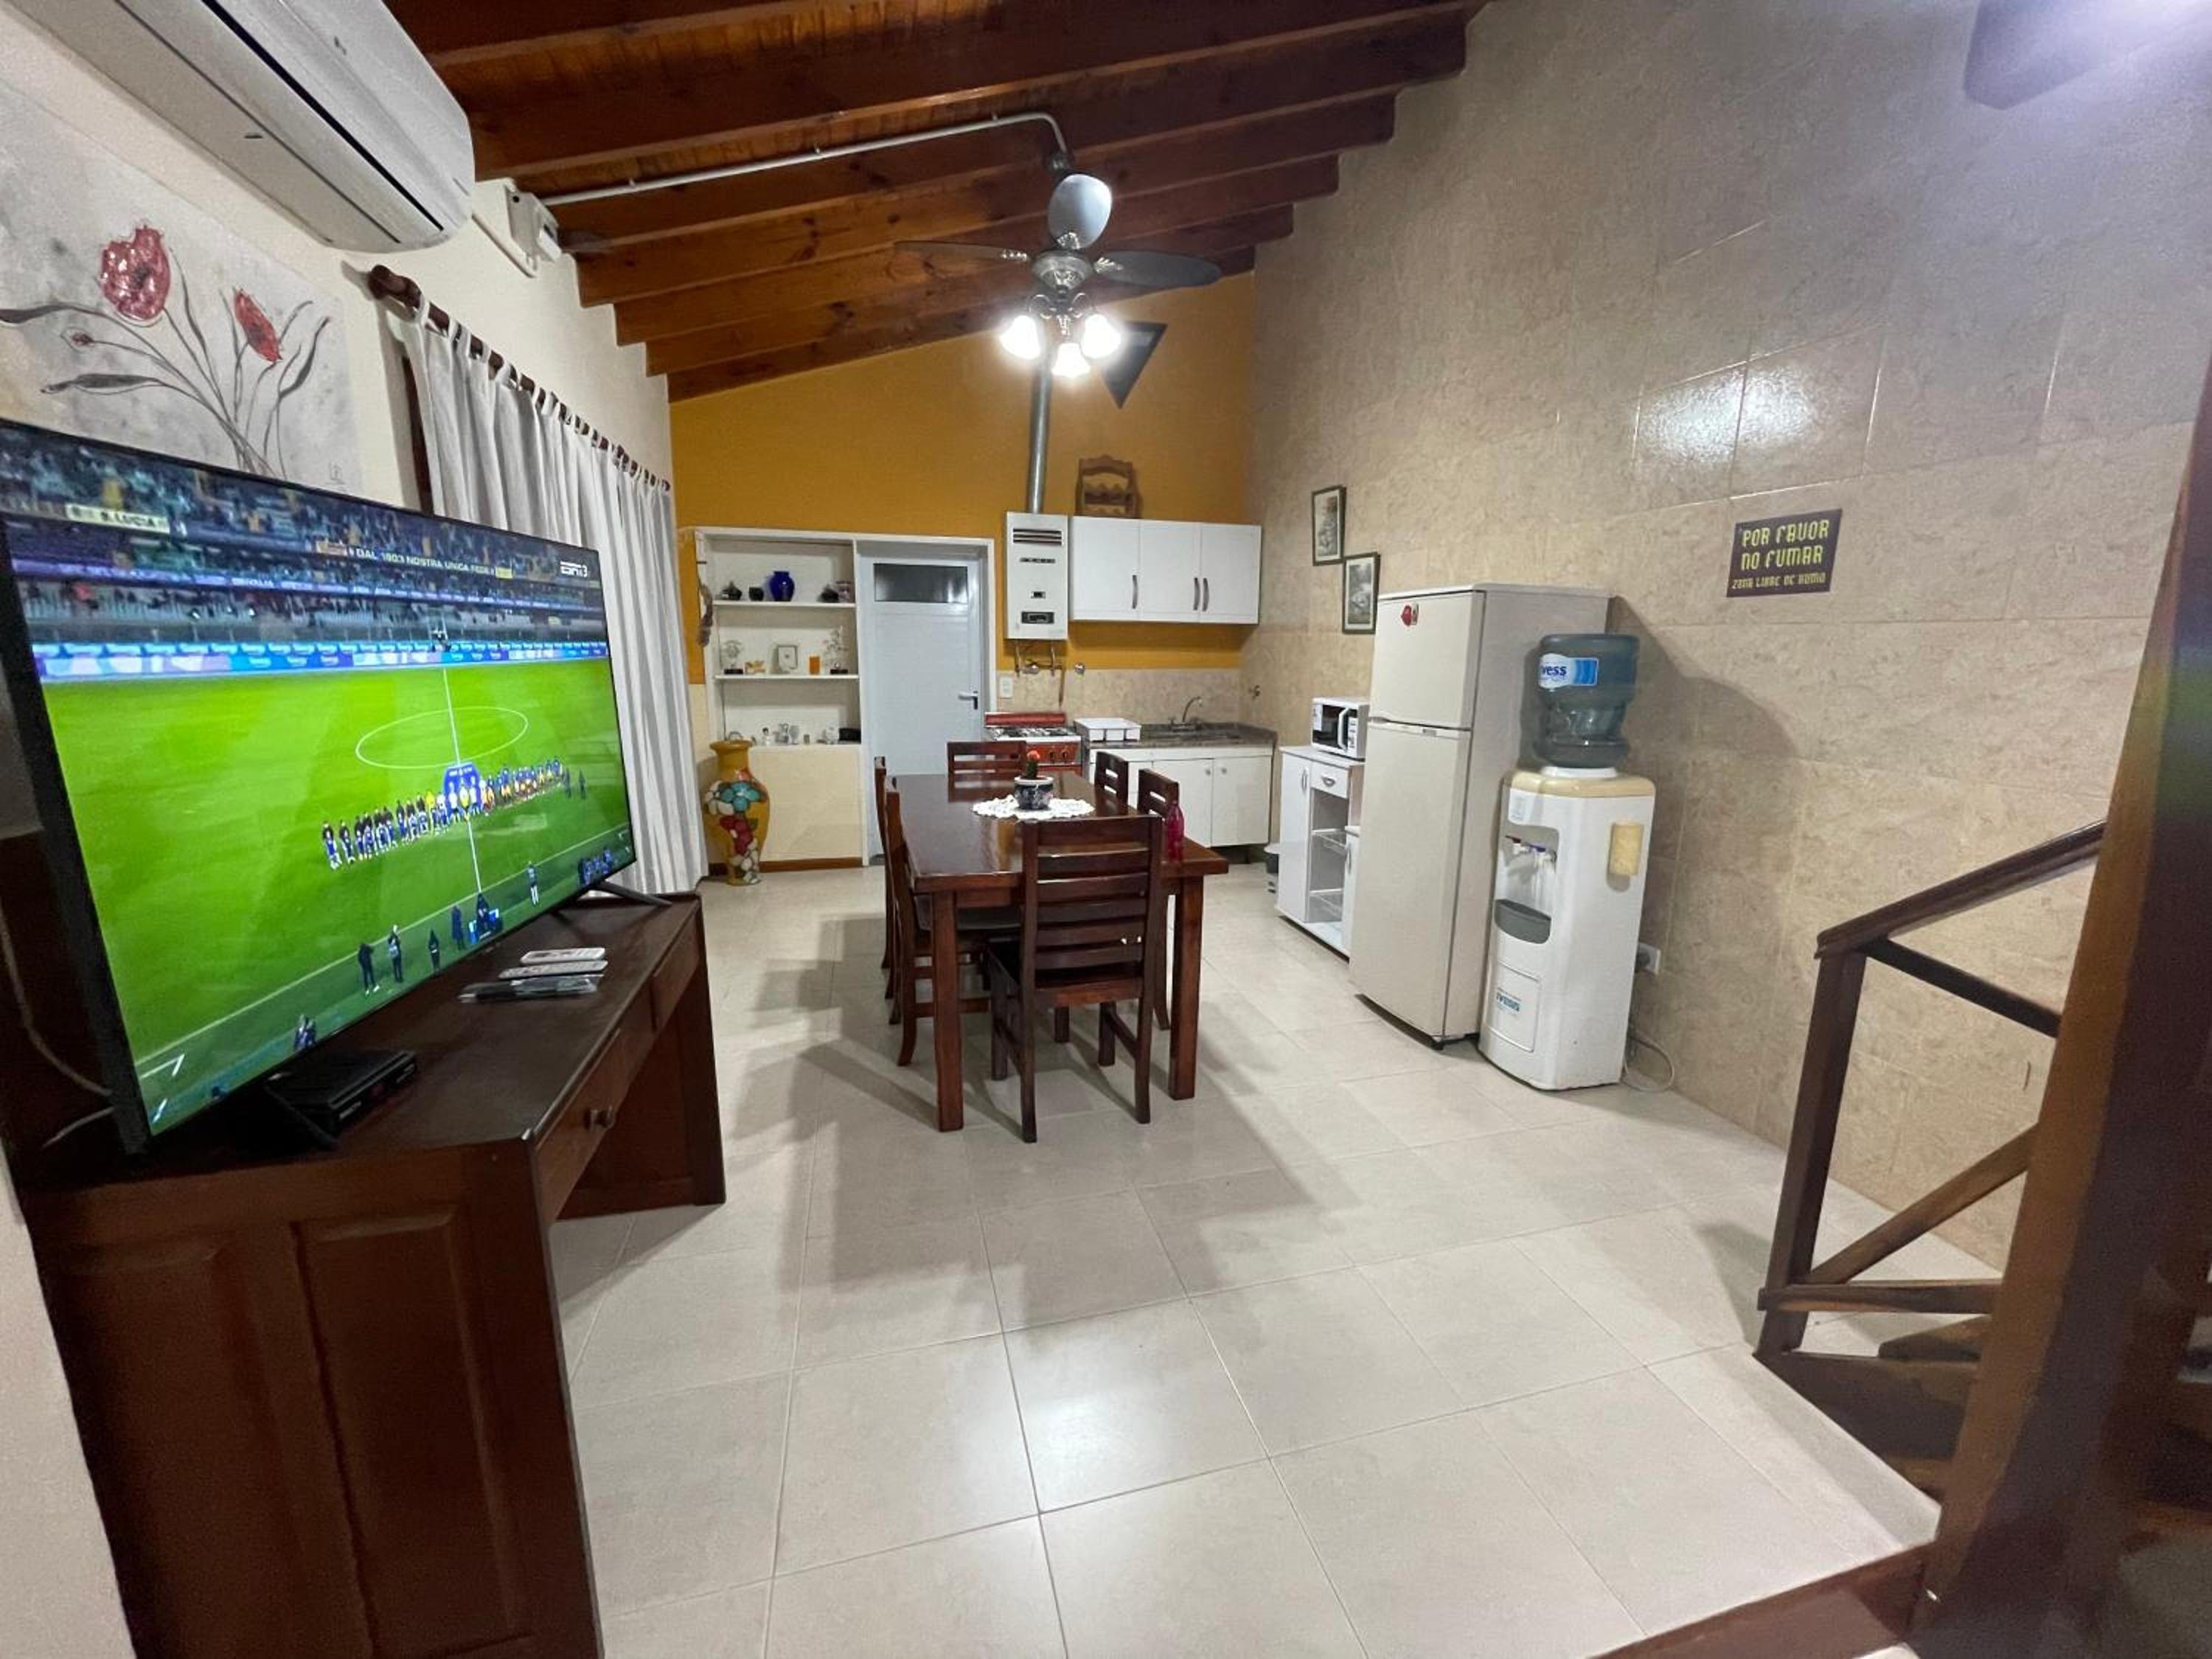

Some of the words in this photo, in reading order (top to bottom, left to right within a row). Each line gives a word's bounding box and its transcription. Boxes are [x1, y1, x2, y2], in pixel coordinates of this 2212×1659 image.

[1742, 527, 1770, 548] POR
[1775, 519, 1829, 544] FAVOR
[1741, 552, 1760, 571] NO
[1765, 545, 1823, 568] FUMAR
